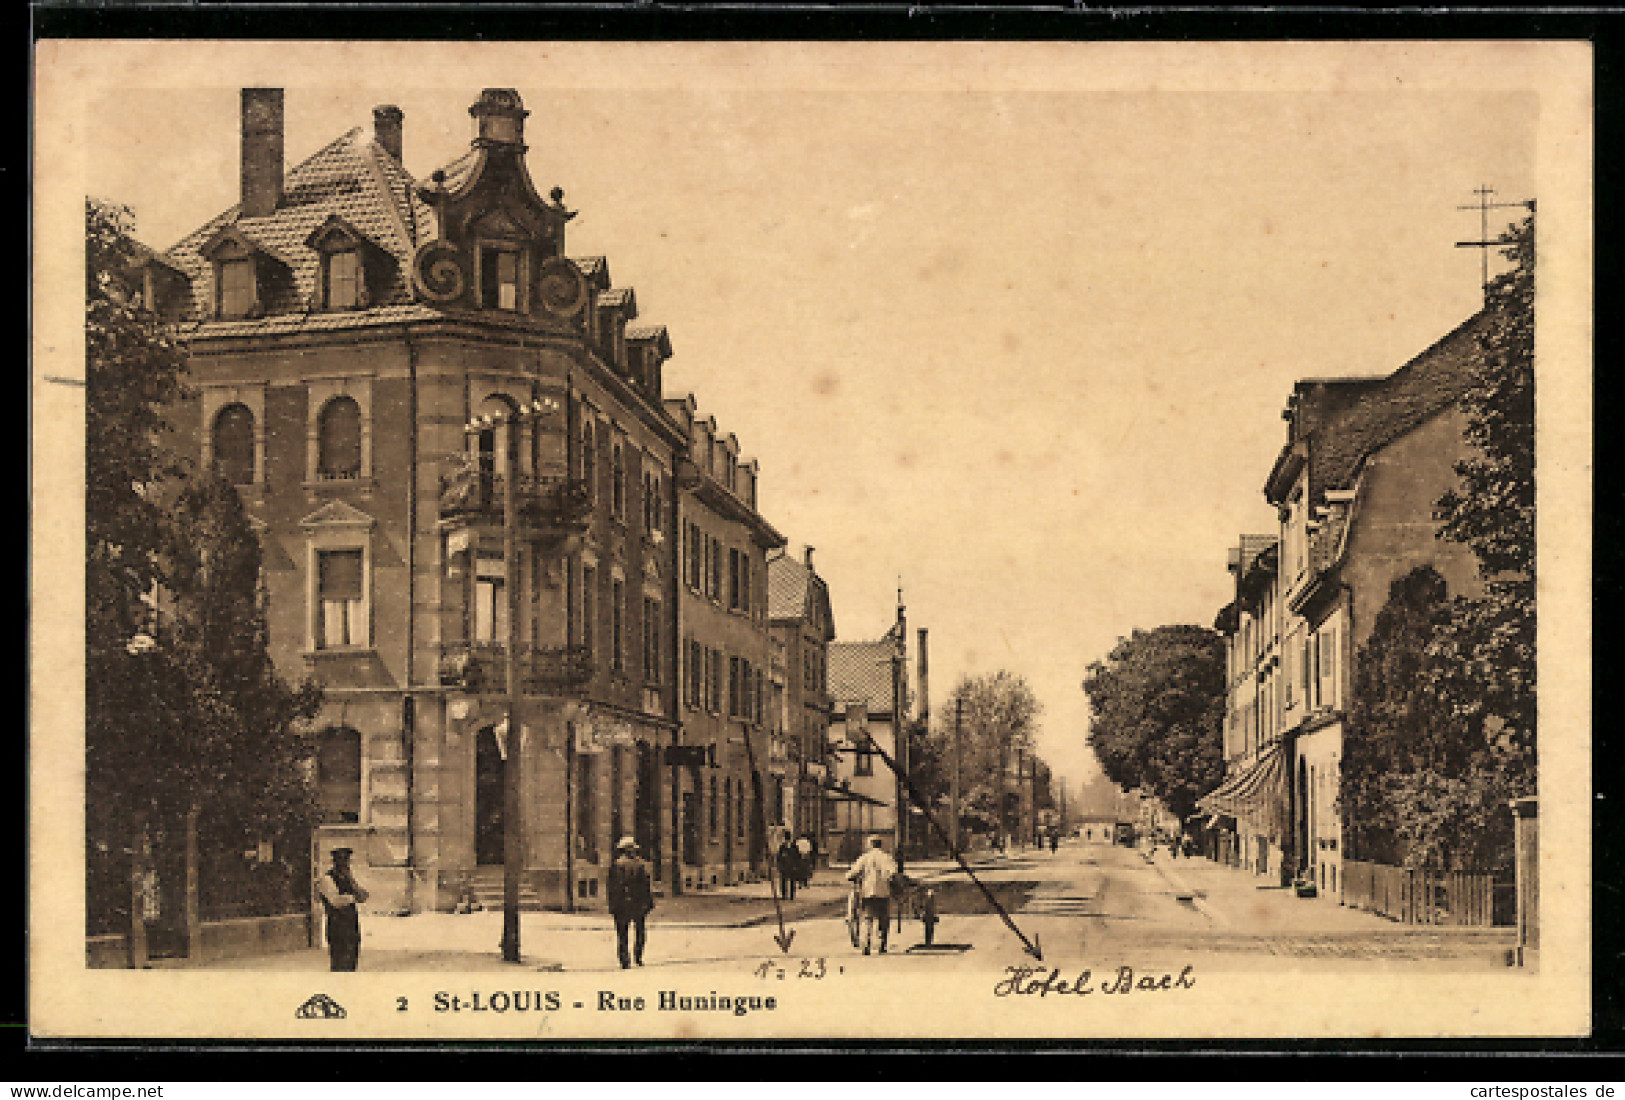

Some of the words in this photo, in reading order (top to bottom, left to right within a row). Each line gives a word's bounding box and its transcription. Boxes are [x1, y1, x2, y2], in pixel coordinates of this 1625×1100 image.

[1101, 964, 1196, 994] Bach
[396, 996, 409, 1011] 2
[434, 991, 561, 1013] St-LOUIS
[597, 991, 645, 1011] Rue
[658, 991, 777, 1016] Huningue
